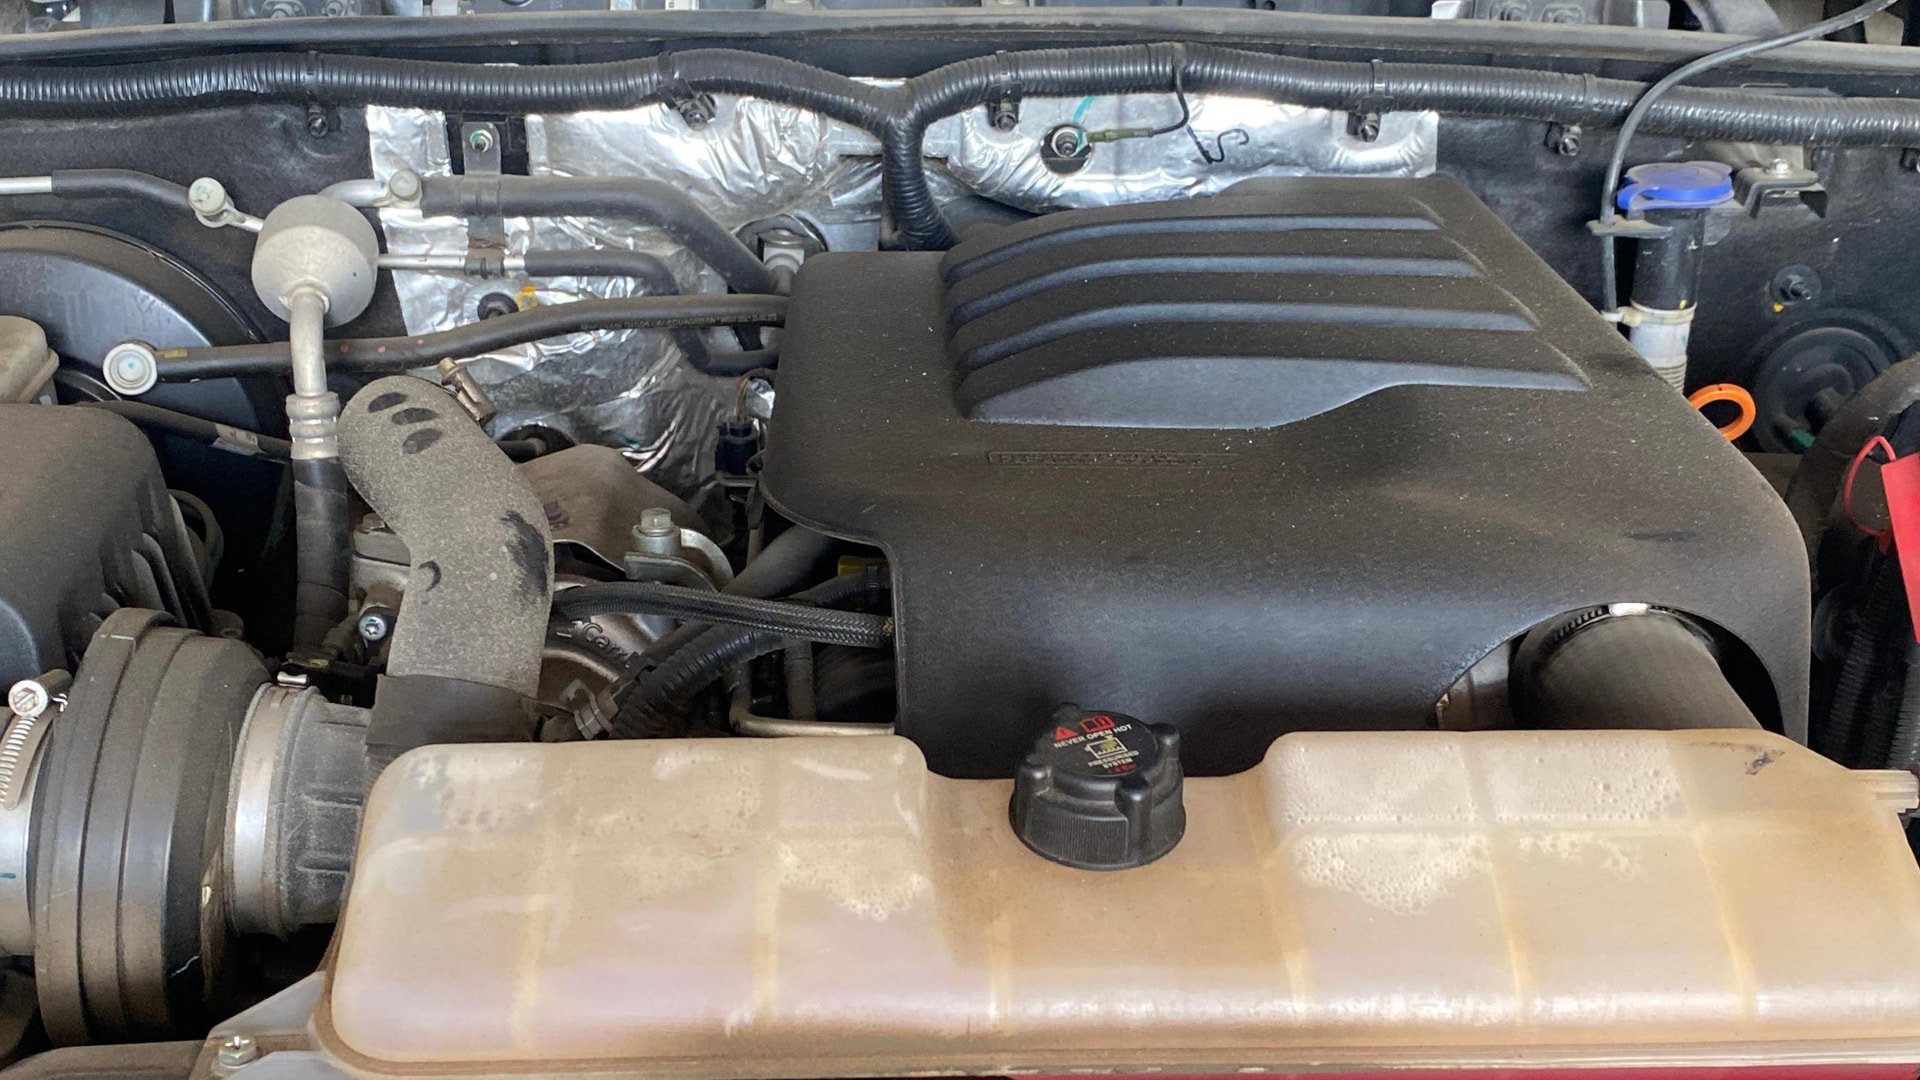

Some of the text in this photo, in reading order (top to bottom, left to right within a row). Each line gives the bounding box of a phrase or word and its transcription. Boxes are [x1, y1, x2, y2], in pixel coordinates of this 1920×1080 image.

[1053, 724, 1132, 748] NEVER OPEN HOT
[1102, 757, 1133, 769] SYSTEM
